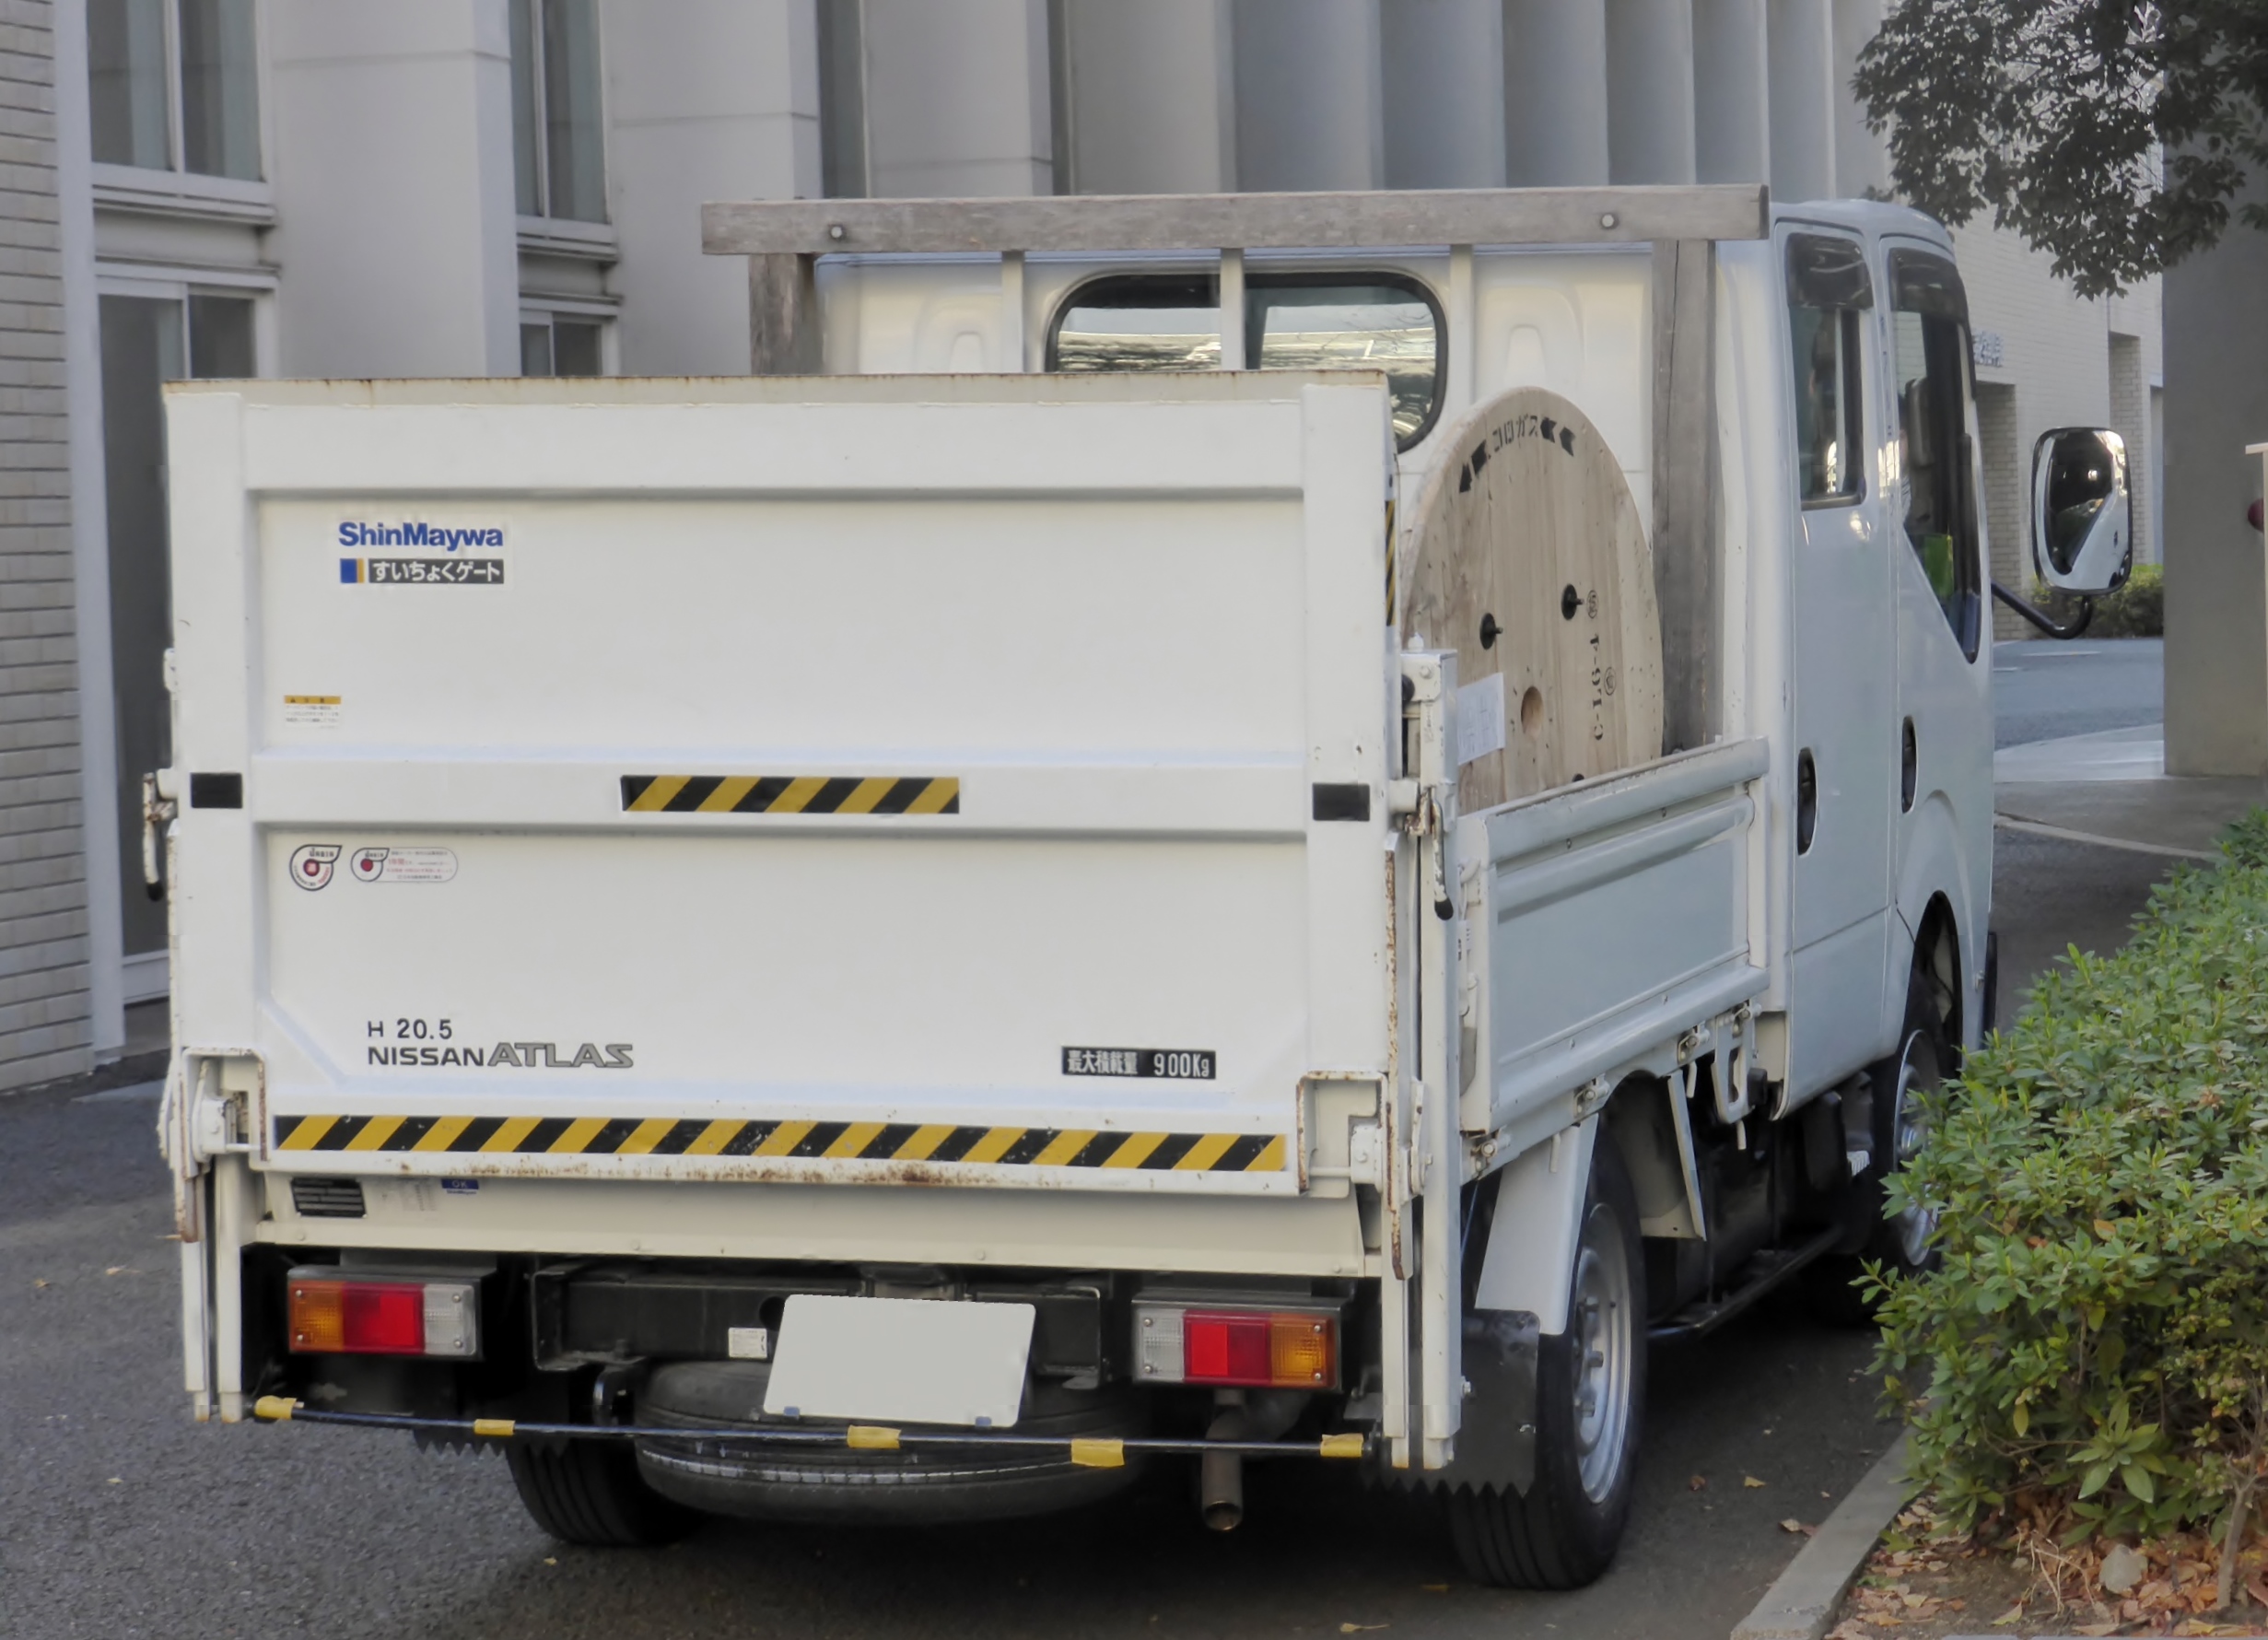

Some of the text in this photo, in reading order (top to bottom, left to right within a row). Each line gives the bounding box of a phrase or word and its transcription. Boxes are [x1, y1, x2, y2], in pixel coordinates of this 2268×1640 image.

[339, 521, 504, 551] ShinMaywa
[372, 561, 500, 582] すいちょくゲート
[368, 1019, 452, 1039] H 20.5
[368, 1043, 634, 1068] NISSAN ATLAS
[1067, 1049, 1139, 1075] 最大積載量
[451, 1179, 467, 1189] OK
